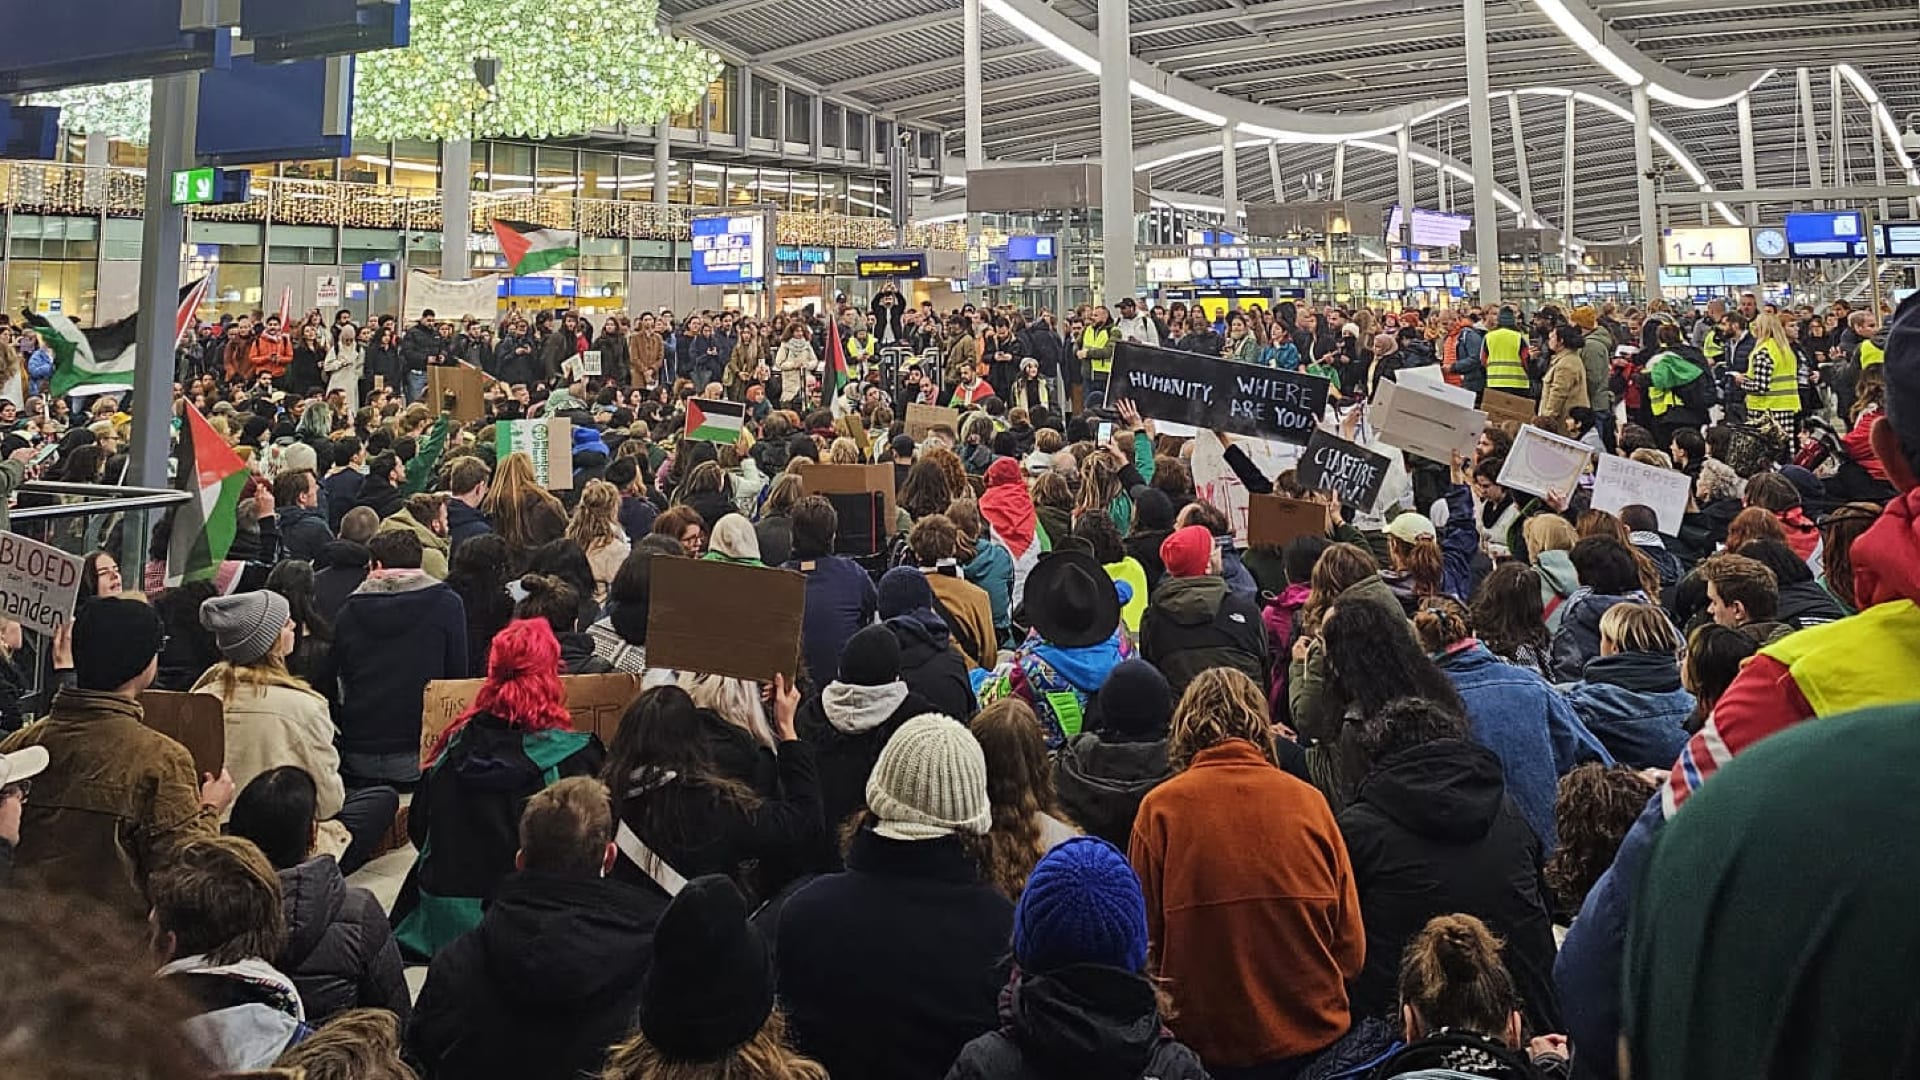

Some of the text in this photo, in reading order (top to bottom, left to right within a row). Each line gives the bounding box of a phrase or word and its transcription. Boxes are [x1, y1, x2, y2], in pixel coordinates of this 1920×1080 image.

[1129, 371, 1313, 410] HUMANITY, WHERE
[1230, 399, 1265, 420] ARE
[1314, 447, 1379, 489] CEASEFIRE
[0, 537, 76, 588] BLOED
